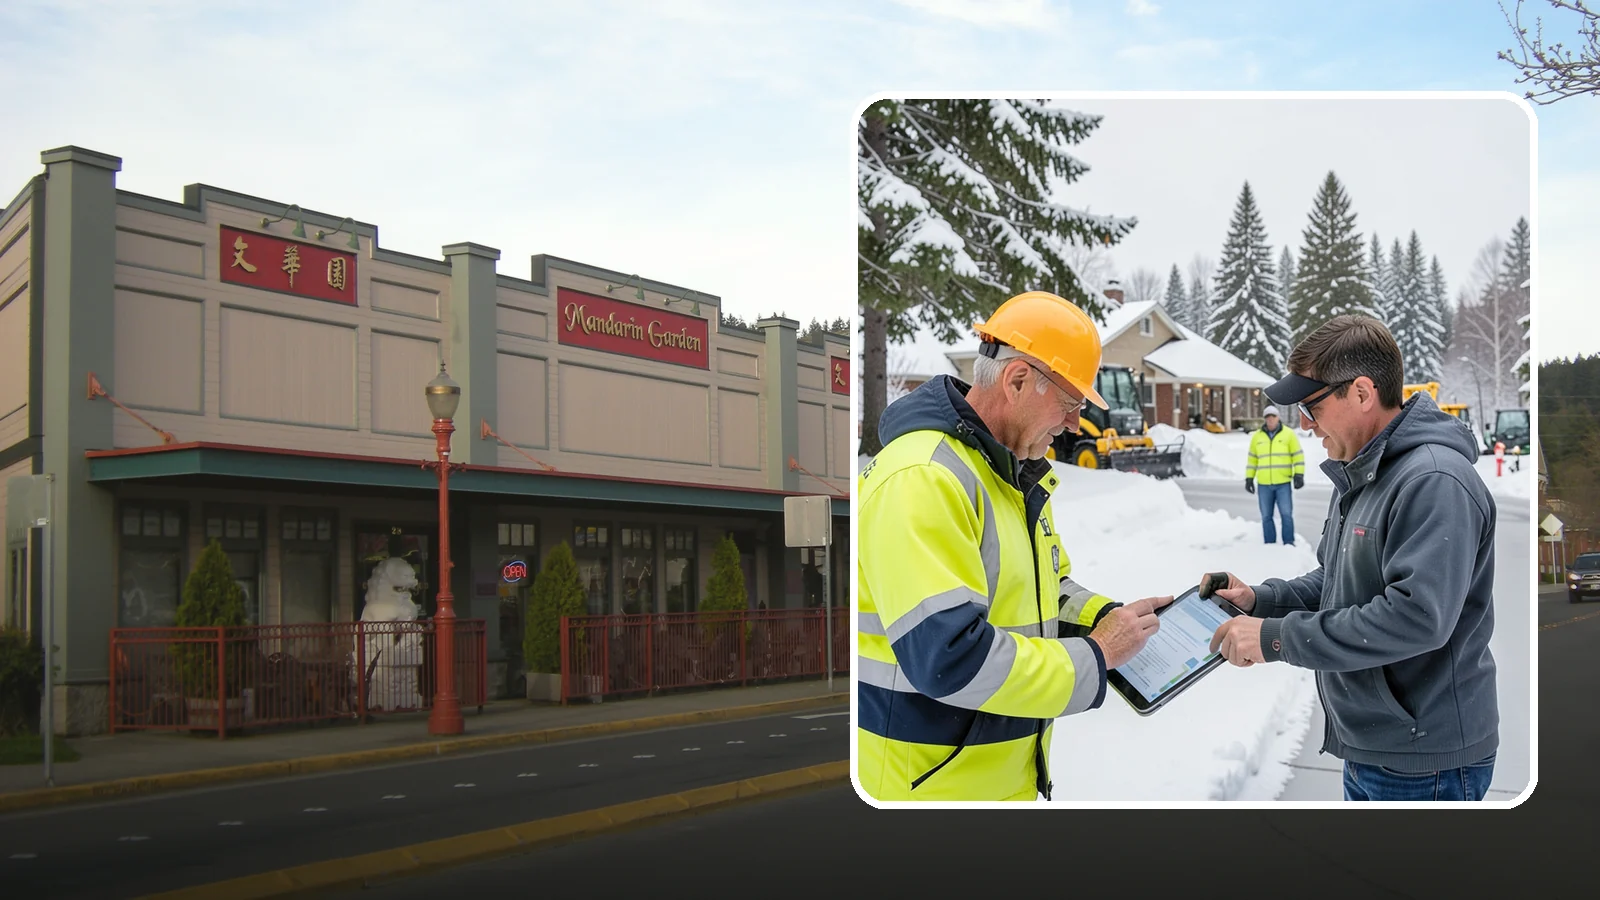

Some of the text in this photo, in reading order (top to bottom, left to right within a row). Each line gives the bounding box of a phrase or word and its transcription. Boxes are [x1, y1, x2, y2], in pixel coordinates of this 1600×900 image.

[230, 235, 346, 291] 文華園
[564, 302, 701, 352] Mandarin Garden
[503, 565, 527, 578] OPEN
